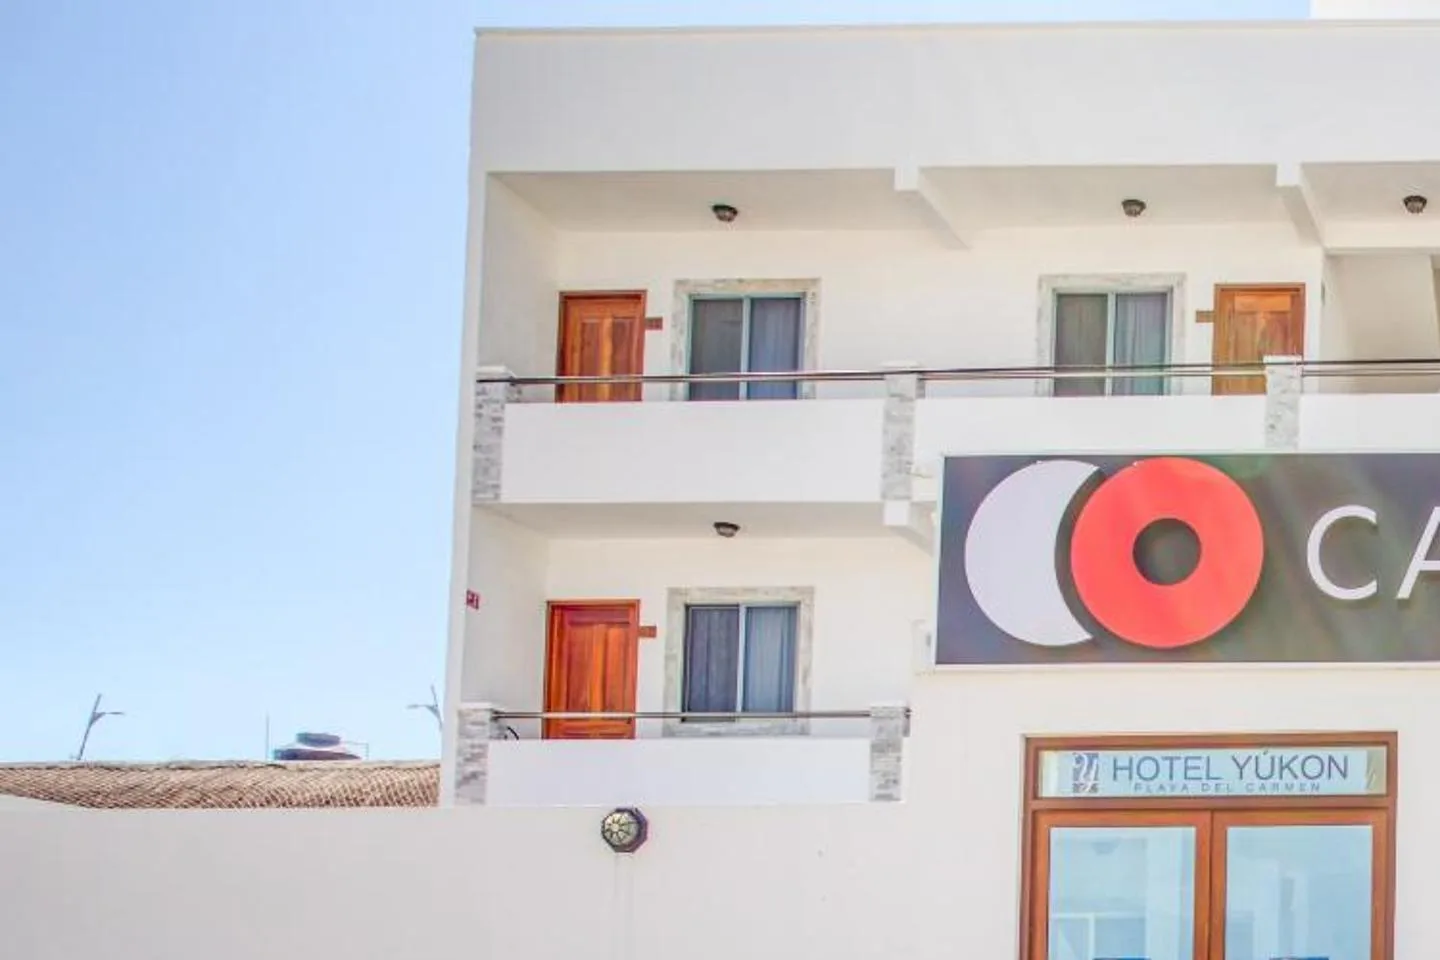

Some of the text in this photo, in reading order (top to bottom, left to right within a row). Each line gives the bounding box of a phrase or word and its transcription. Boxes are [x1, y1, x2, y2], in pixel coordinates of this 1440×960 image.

[1112, 755, 1223, 782] HOTEL
[1133, 781, 1321, 793] PLAYA DEL CARMEN
